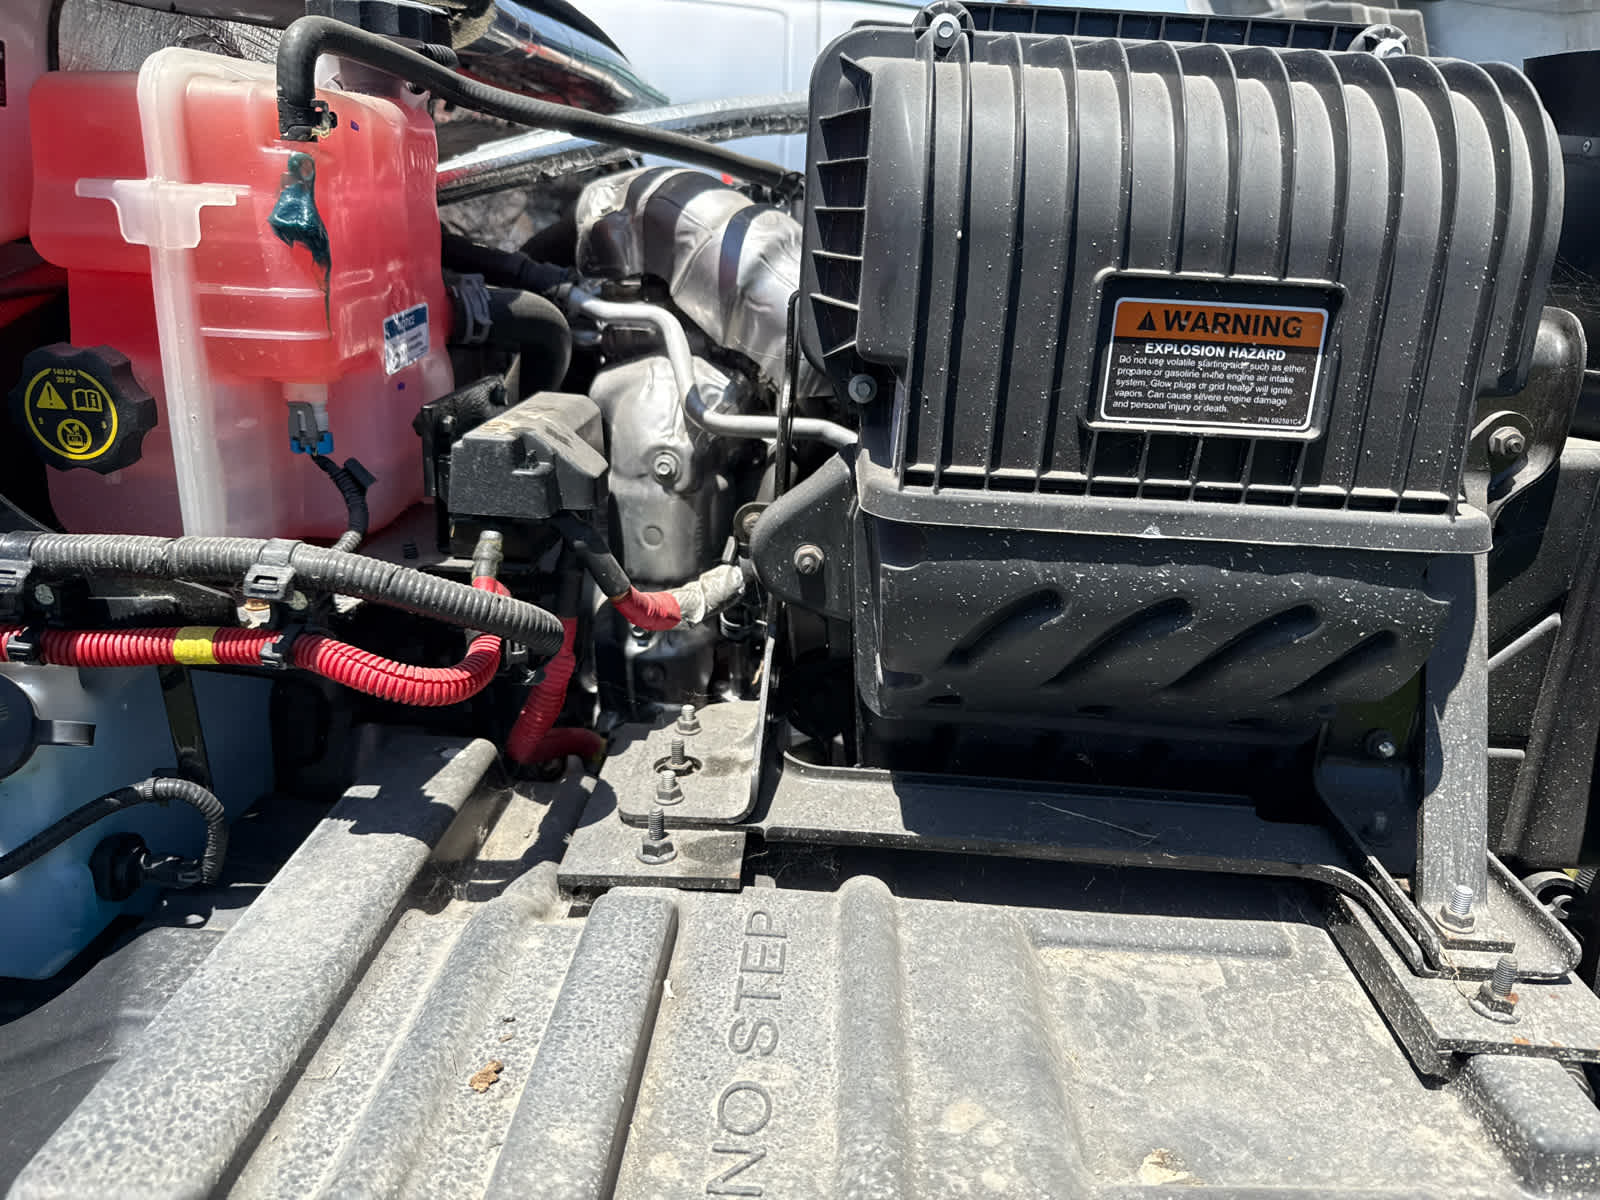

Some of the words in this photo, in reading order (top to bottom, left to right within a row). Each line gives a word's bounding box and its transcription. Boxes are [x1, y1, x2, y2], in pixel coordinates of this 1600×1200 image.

[1163, 309, 1303, 338] WARNING
[1144, 342, 1225, 357] EXPLOSION
[1228, 346, 1286, 361] HAZARD
[1119, 354, 1132, 364] Do
[1133, 356, 1147, 365] not
[1148, 358, 1164, 367] use
[1166, 357, 1196, 367] volatile
[1198, 359, 1228, 371] starting
[1250, 363, 1270, 371] such
[1271, 364, 1282, 372] as
[1117, 368, 1152, 378] propane
[1164, 370, 1200, 379] gasoline
[1210, 370, 1225, 379] the
[1226, 373, 1255, 382] engine
[1256, 374, 1267, 382] air
[1269, 374, 1295, 384] intake
[1116, 379, 1148, 388] system.
[1150, 379, 1172, 388] Glow
[1173, 380, 1197, 391] plugs
[1208, 382, 1225, 392] grid
[1255, 385, 1269, 393] will
[1270, 386, 1294, 396] ignite
[1112, 400, 1130, 408] and
[1130, 401, 1168, 410] personal
[1168, 402, 1192, 413] injury
[1147, 390, 1165, 399] Can
[1193, 393, 1222, 402] severe
[1223, 395, 1252, 404] engine
[1253, 396, 1288, 407] damage
[727, 909, 788, 1057] STEP
[705, 1080, 773, 1198] NO
